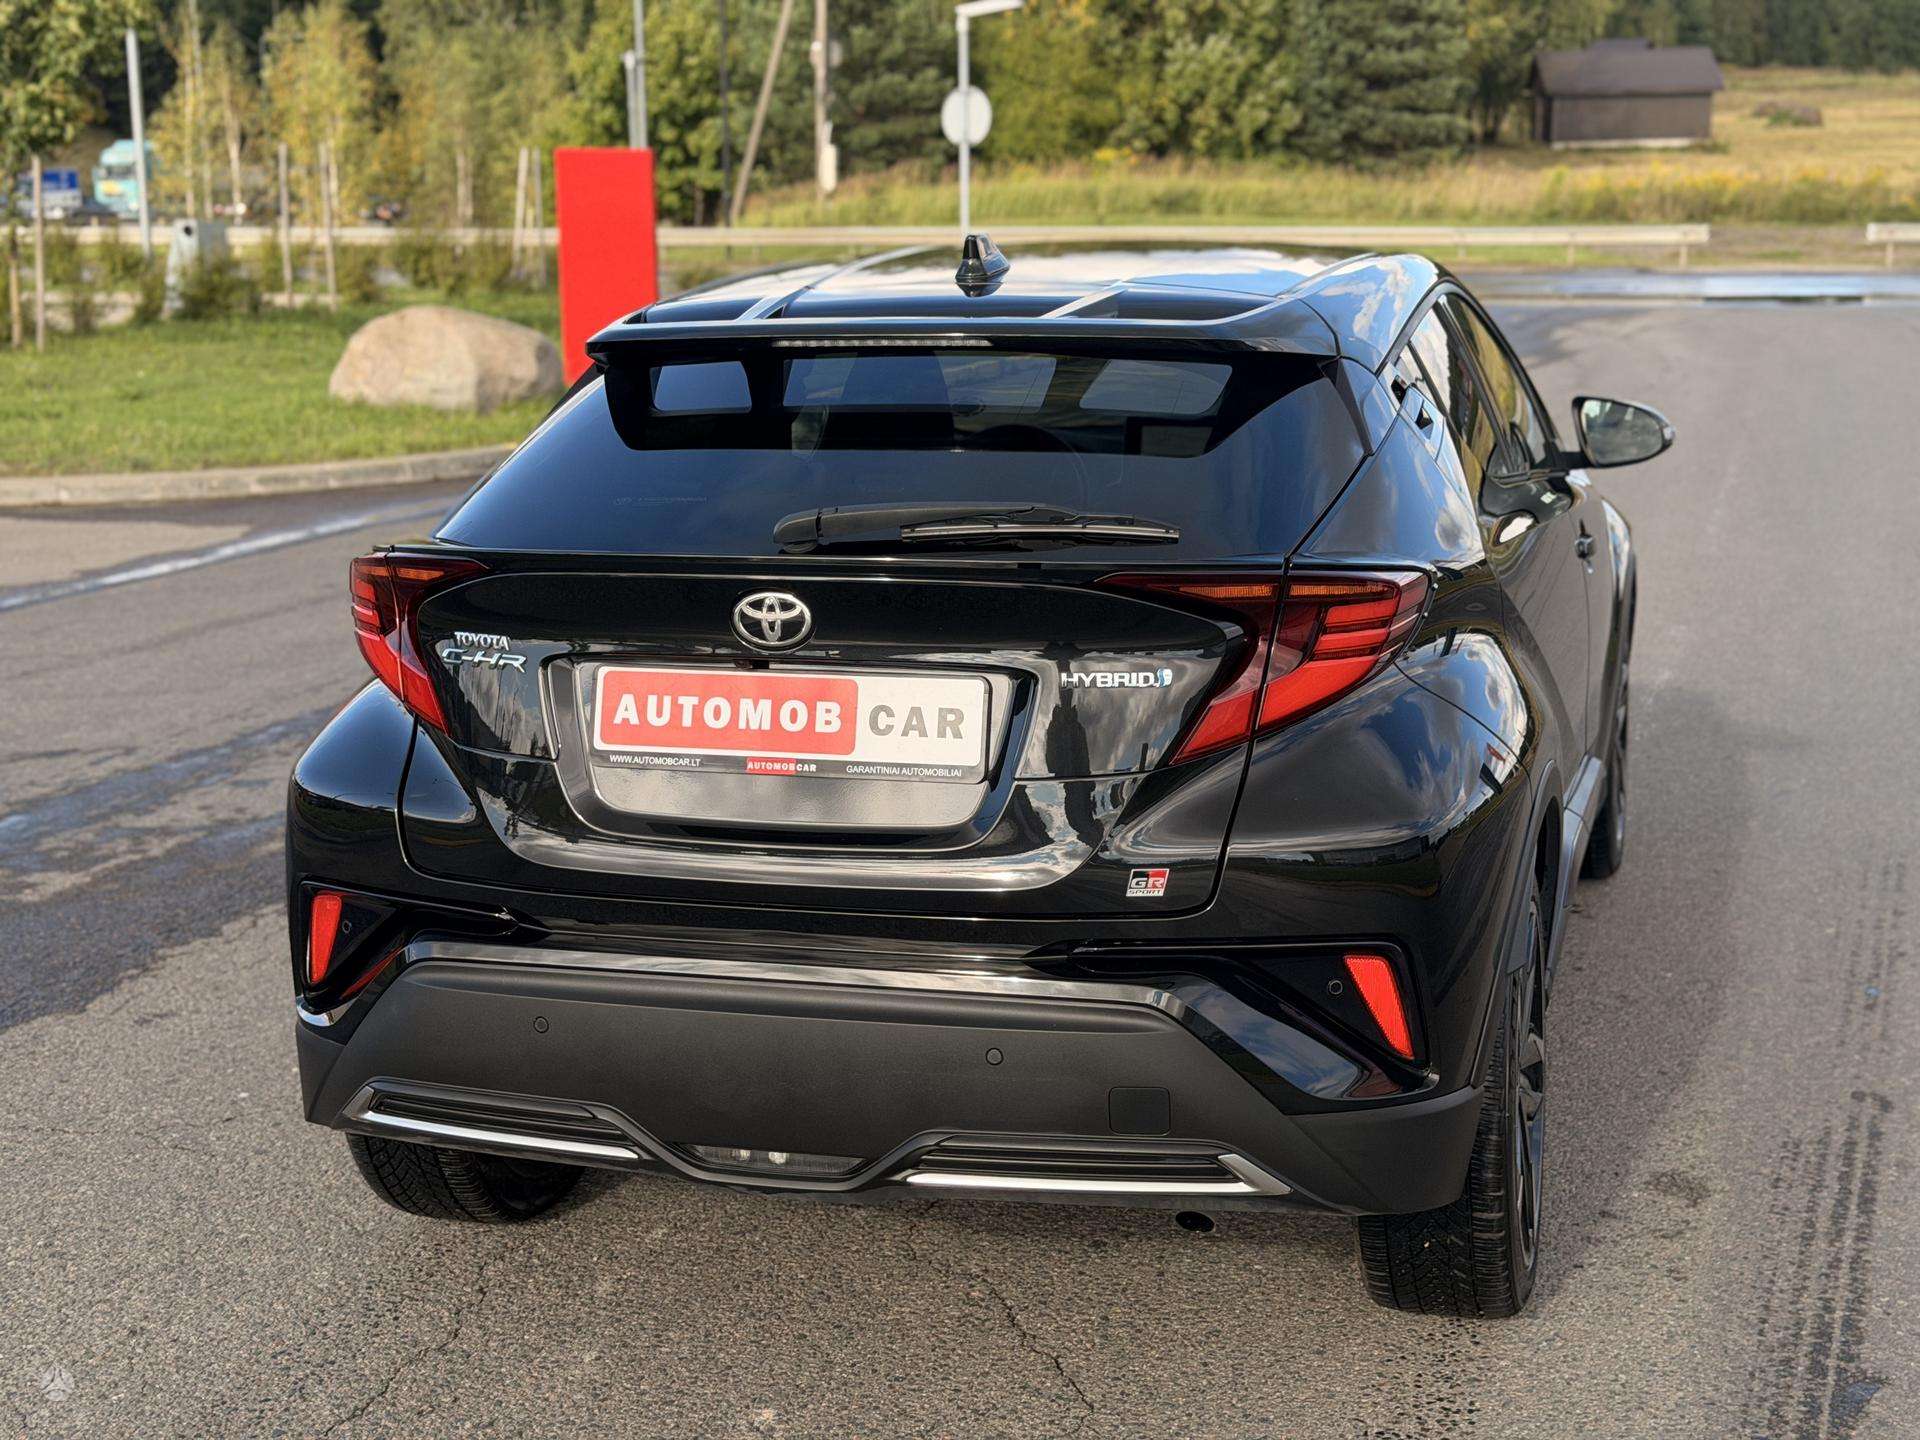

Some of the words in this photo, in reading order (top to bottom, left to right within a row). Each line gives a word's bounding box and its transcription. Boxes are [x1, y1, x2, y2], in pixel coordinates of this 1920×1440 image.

[454, 631, 510, 651] TOYOTA
[441, 648, 527, 673] C-HR
[1060, 672, 1154, 688] HYBRID
[612, 693, 843, 734] AUTOMOB
[868, 704, 965, 740] CAR
[609, 754, 701, 767] WWW.AUTOMOBCAR.LT
[846, 765, 900, 775] GARANTINIAI
[901, 767, 962, 777] AUTOMOBILIAI
[1130, 877, 1166, 889] GR
